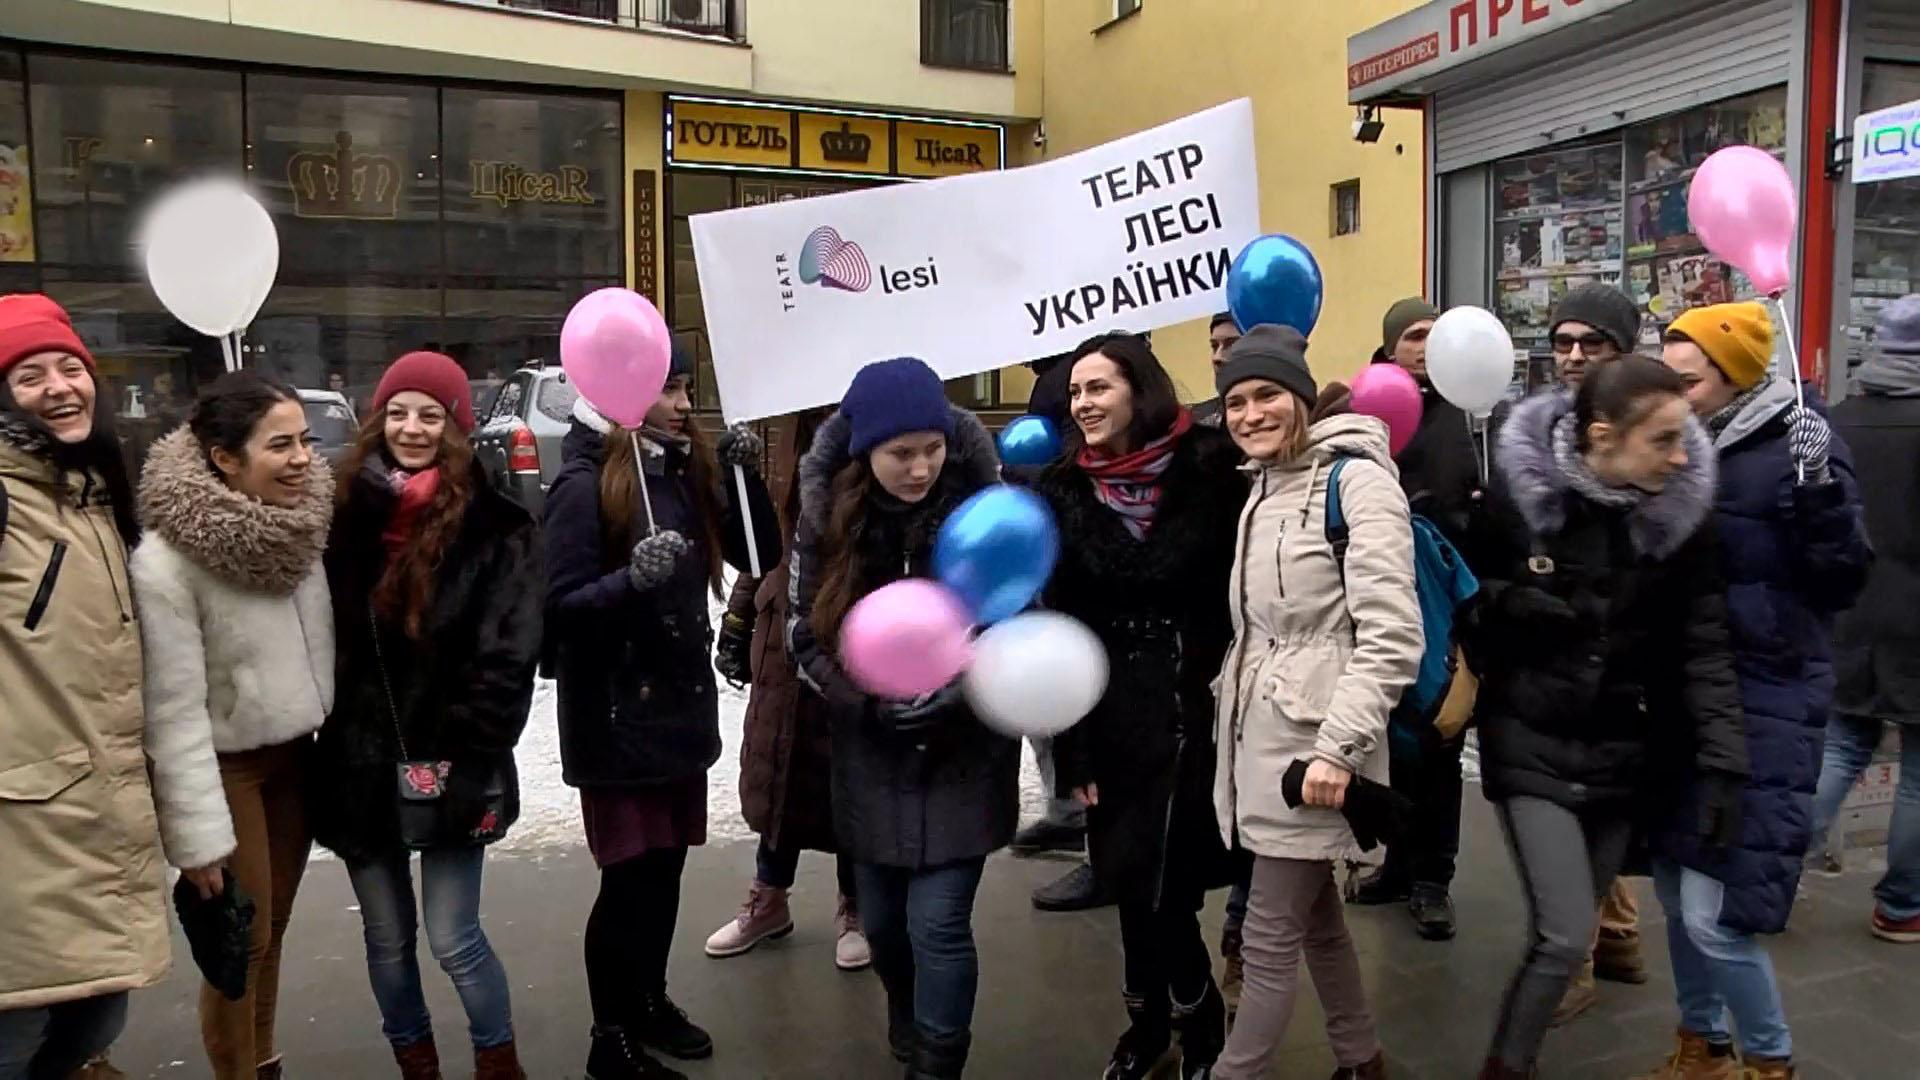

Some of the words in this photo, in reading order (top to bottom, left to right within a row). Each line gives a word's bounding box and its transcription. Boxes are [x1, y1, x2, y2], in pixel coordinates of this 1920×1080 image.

[1450, 0, 1584, 52] ПРЕ
[1362, 37, 1437, 80] ІНТЕРПРЕС
[678, 118, 788, 151] ГОТЕЛЬ
[1863, 123, 1920, 160] IQ
[1081, 143, 1204, 209] ТЕАТР
[1124, 193, 1222, 253] ЛЕСІ
[775, 252, 796, 312] TEATR
[879, 256, 939, 294] lesi
[1024, 247, 1233, 336] УКРАЇНКИ
